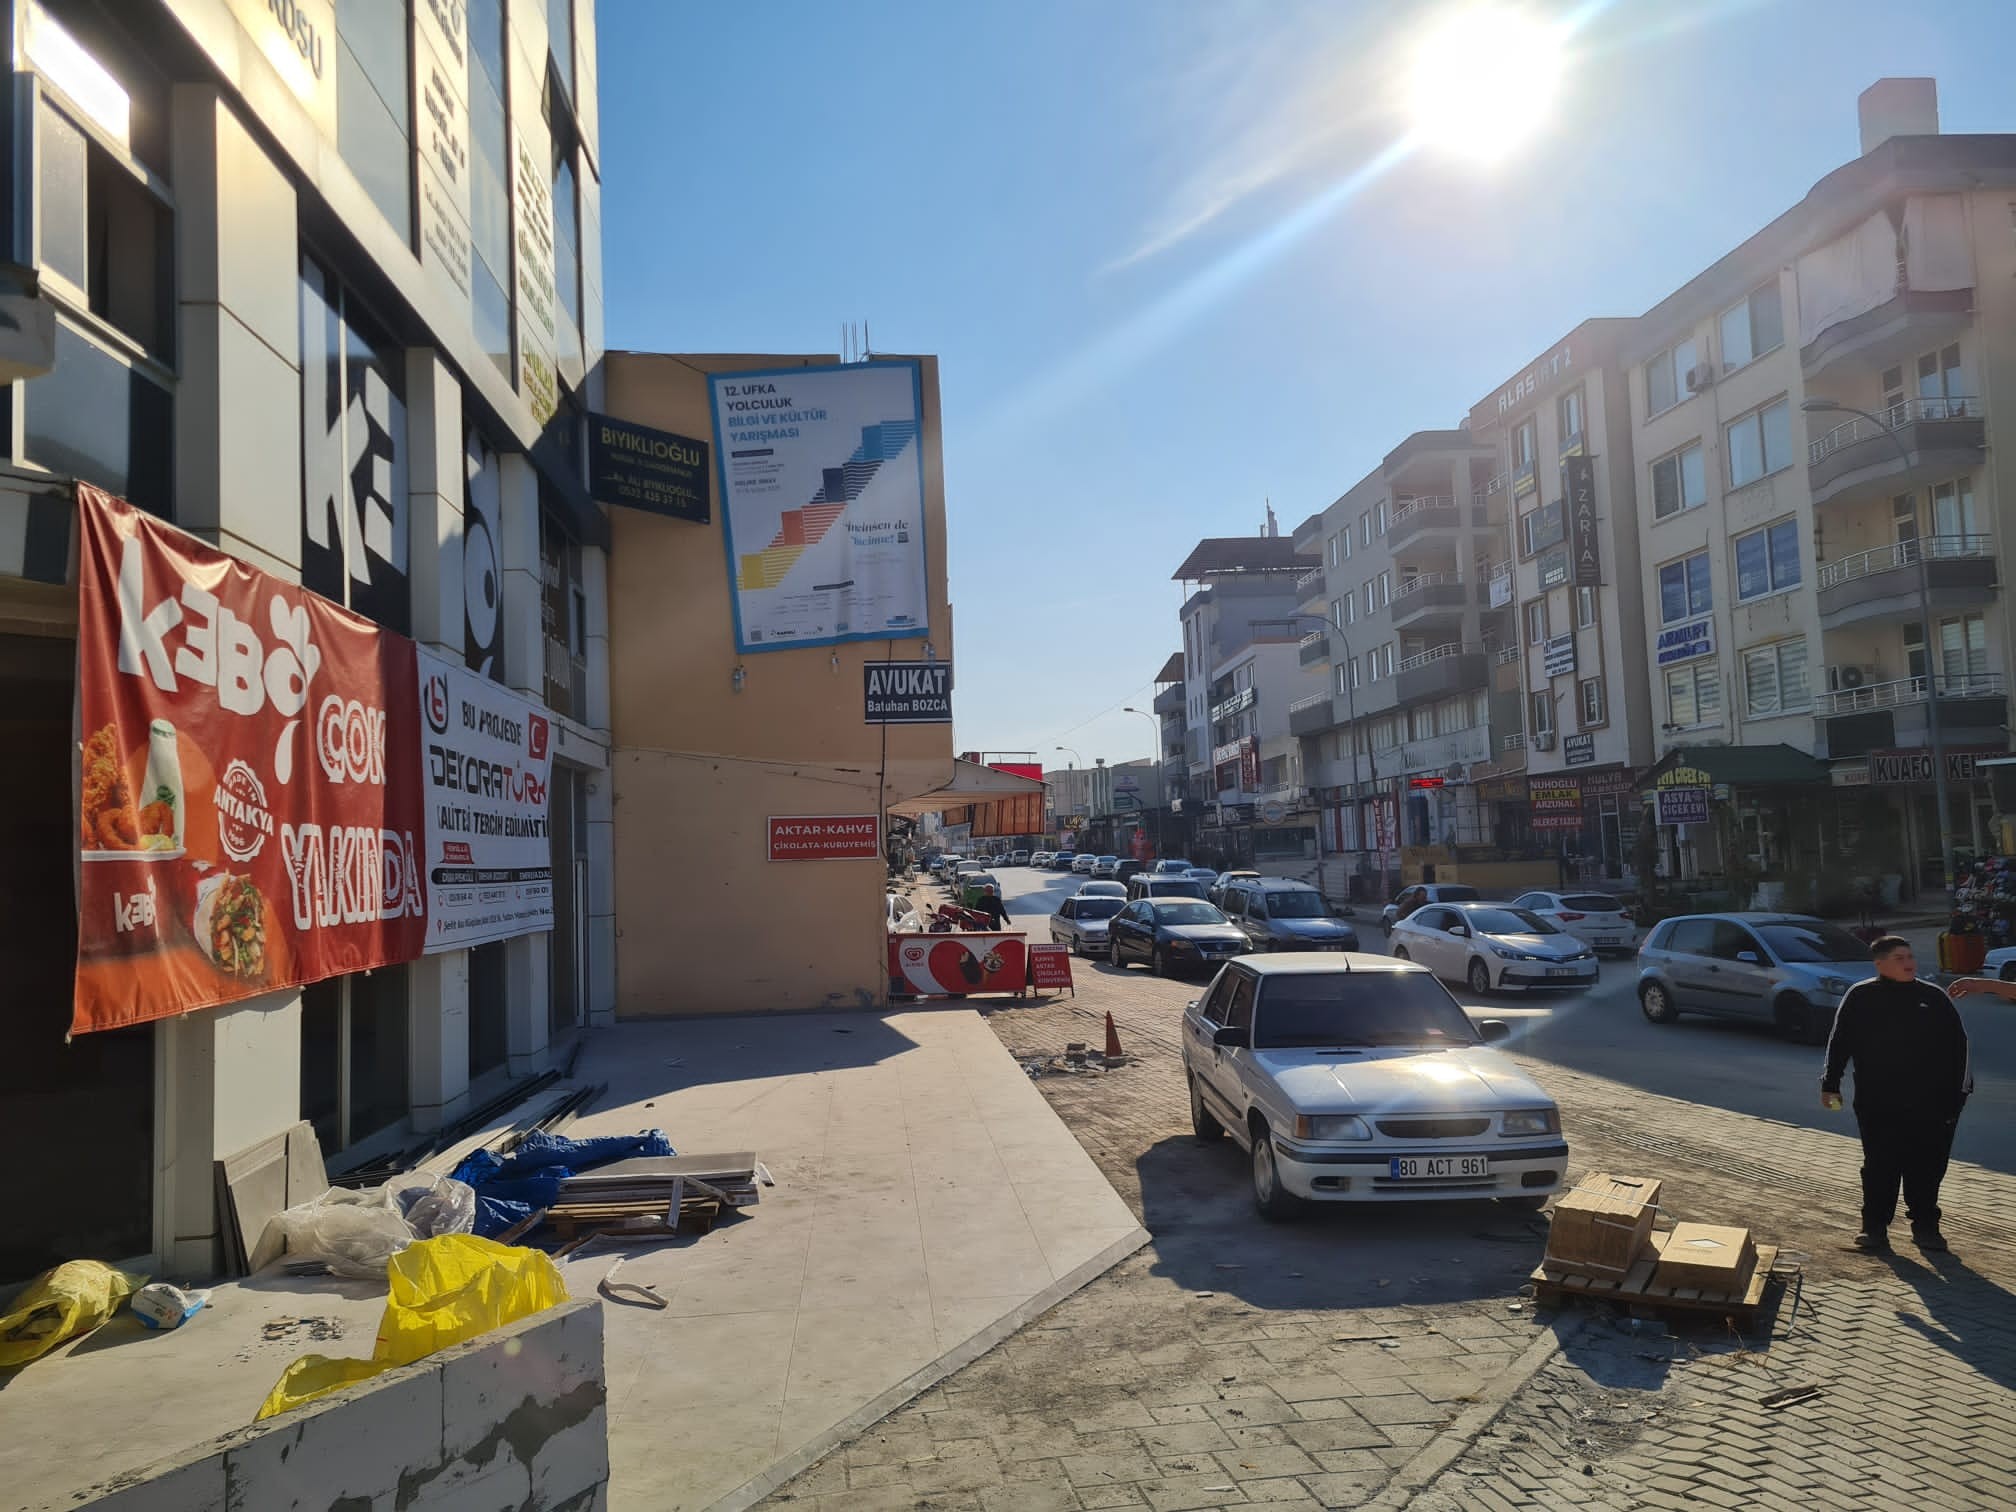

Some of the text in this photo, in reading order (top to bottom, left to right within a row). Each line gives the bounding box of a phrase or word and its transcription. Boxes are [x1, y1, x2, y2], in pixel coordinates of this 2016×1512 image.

[742, 384, 777, 396] UFKA
[727, 398, 793, 412] YOLCULUK
[760, 414, 778, 425] VE
[602, 427, 700, 466] BIYIKLIOĞLU
[869, 669, 946, 695] AVUKAT
[462, 700, 476, 730] BU
[868, 699, 947, 712] Batuhan BOZCA
[1876, 754, 1937, 781] KUAFÖ
[213, 783, 273, 837] ANTAKYA
[473, 810, 503, 837] TERCİH
[775, 824, 873, 836] AKTAR-KAHVE
[280, 823, 424, 931] YAKINDA
[1400, 1158, 1486, 1176] 80 ACT 961
